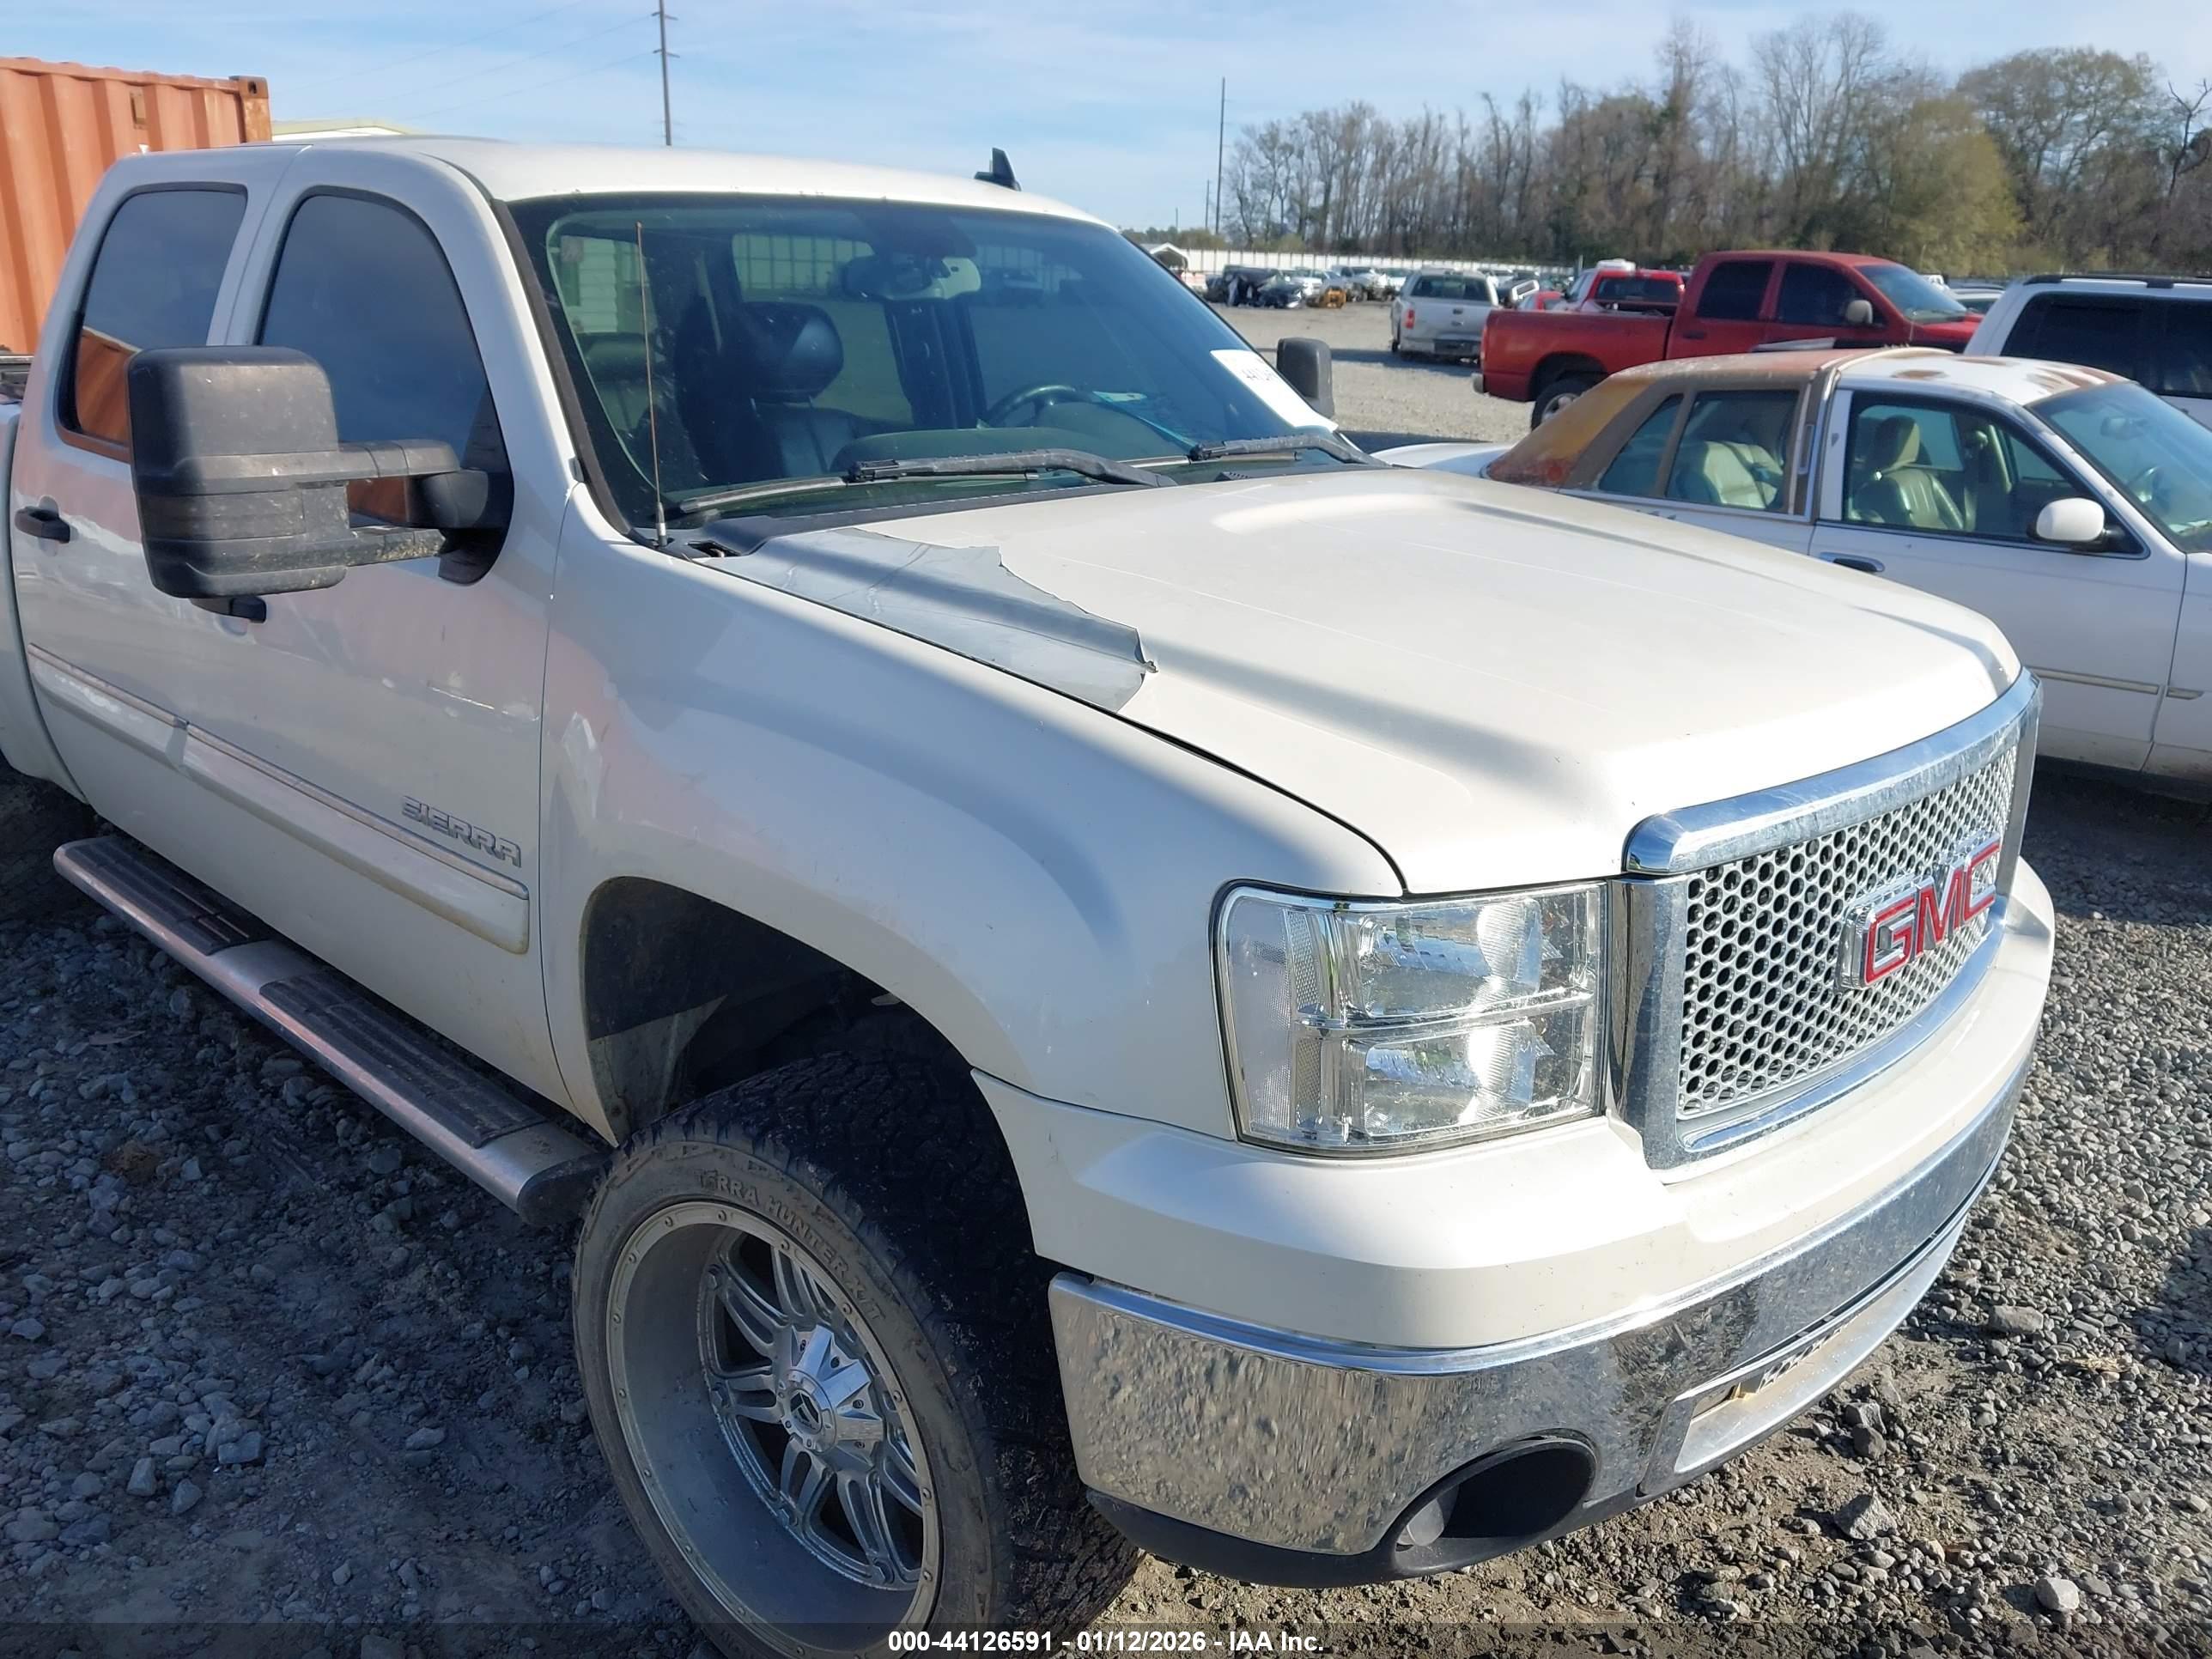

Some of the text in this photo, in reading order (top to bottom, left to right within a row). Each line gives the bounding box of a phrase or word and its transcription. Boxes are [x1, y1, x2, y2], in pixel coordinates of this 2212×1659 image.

[402, 795, 521, 867] SIERRA
[1864, 833, 2002, 985] GMC
[695, 1169, 759, 1205] TERRA
[769, 1194, 850, 1279] HUNTER
